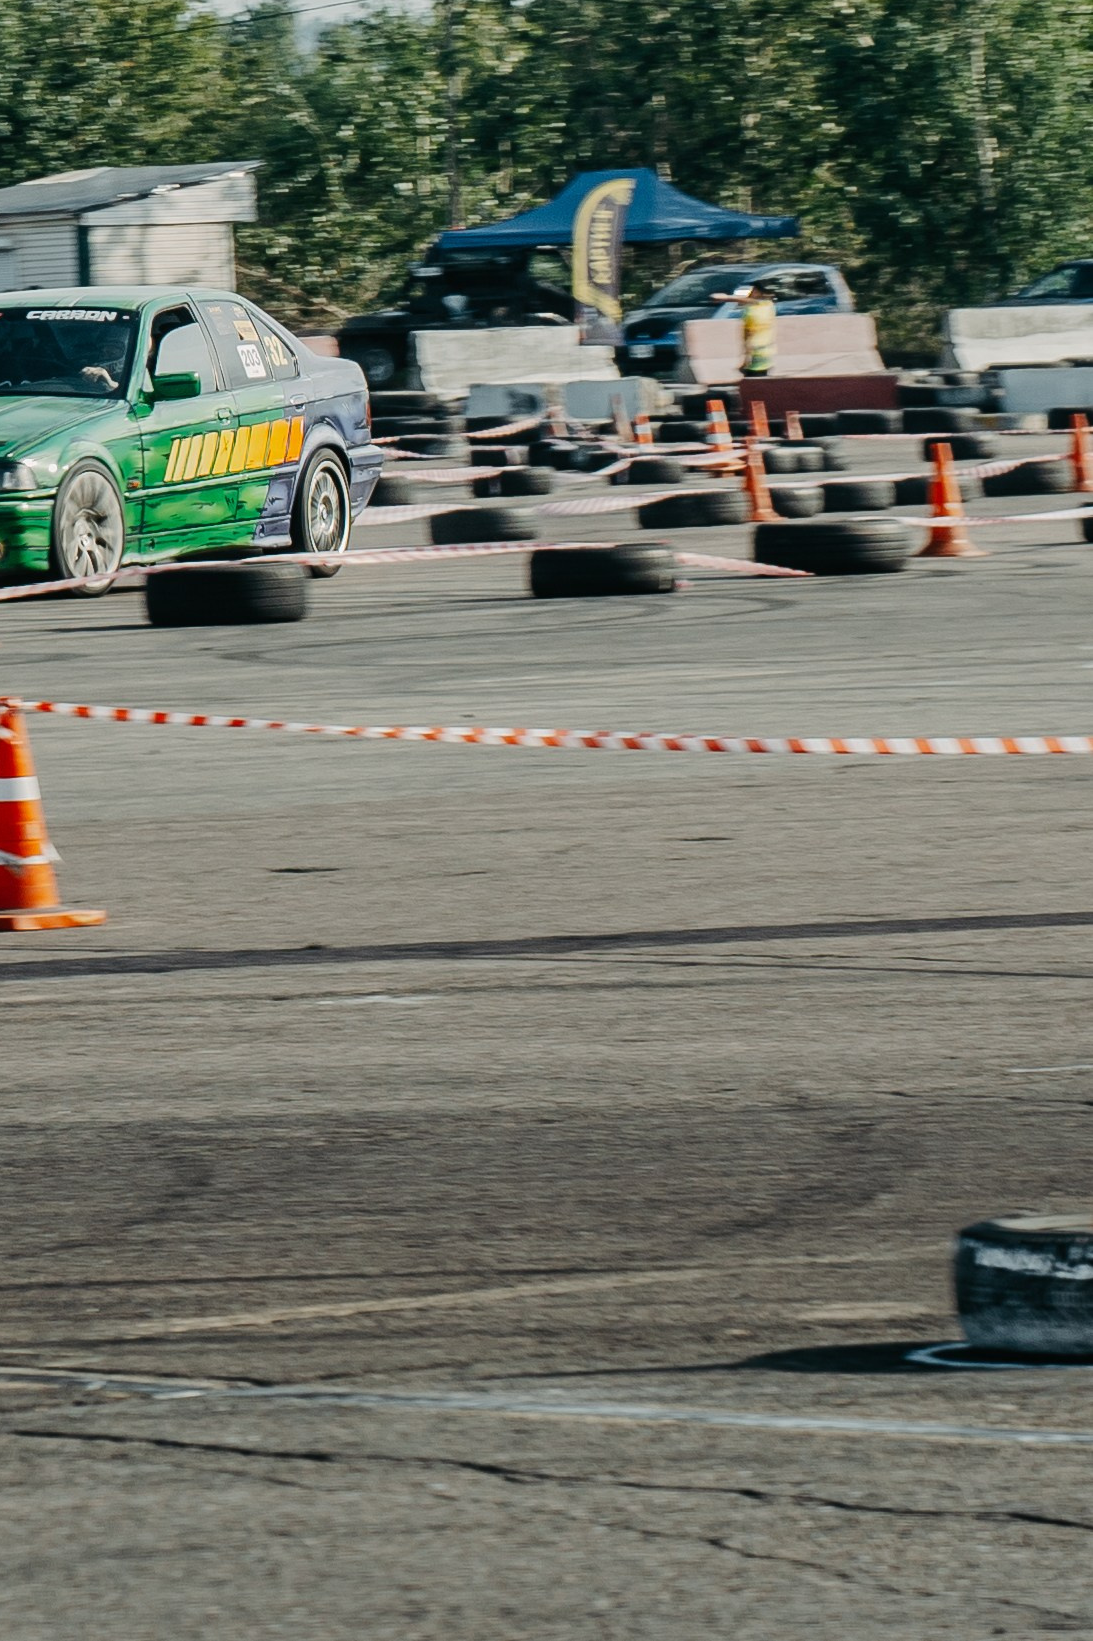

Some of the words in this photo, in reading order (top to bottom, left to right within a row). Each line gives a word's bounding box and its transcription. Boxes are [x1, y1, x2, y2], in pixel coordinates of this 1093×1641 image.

[26, 309, 117, 322] CARBON
[240, 348, 261, 367] 203
[263, 335, 288, 366] 32
